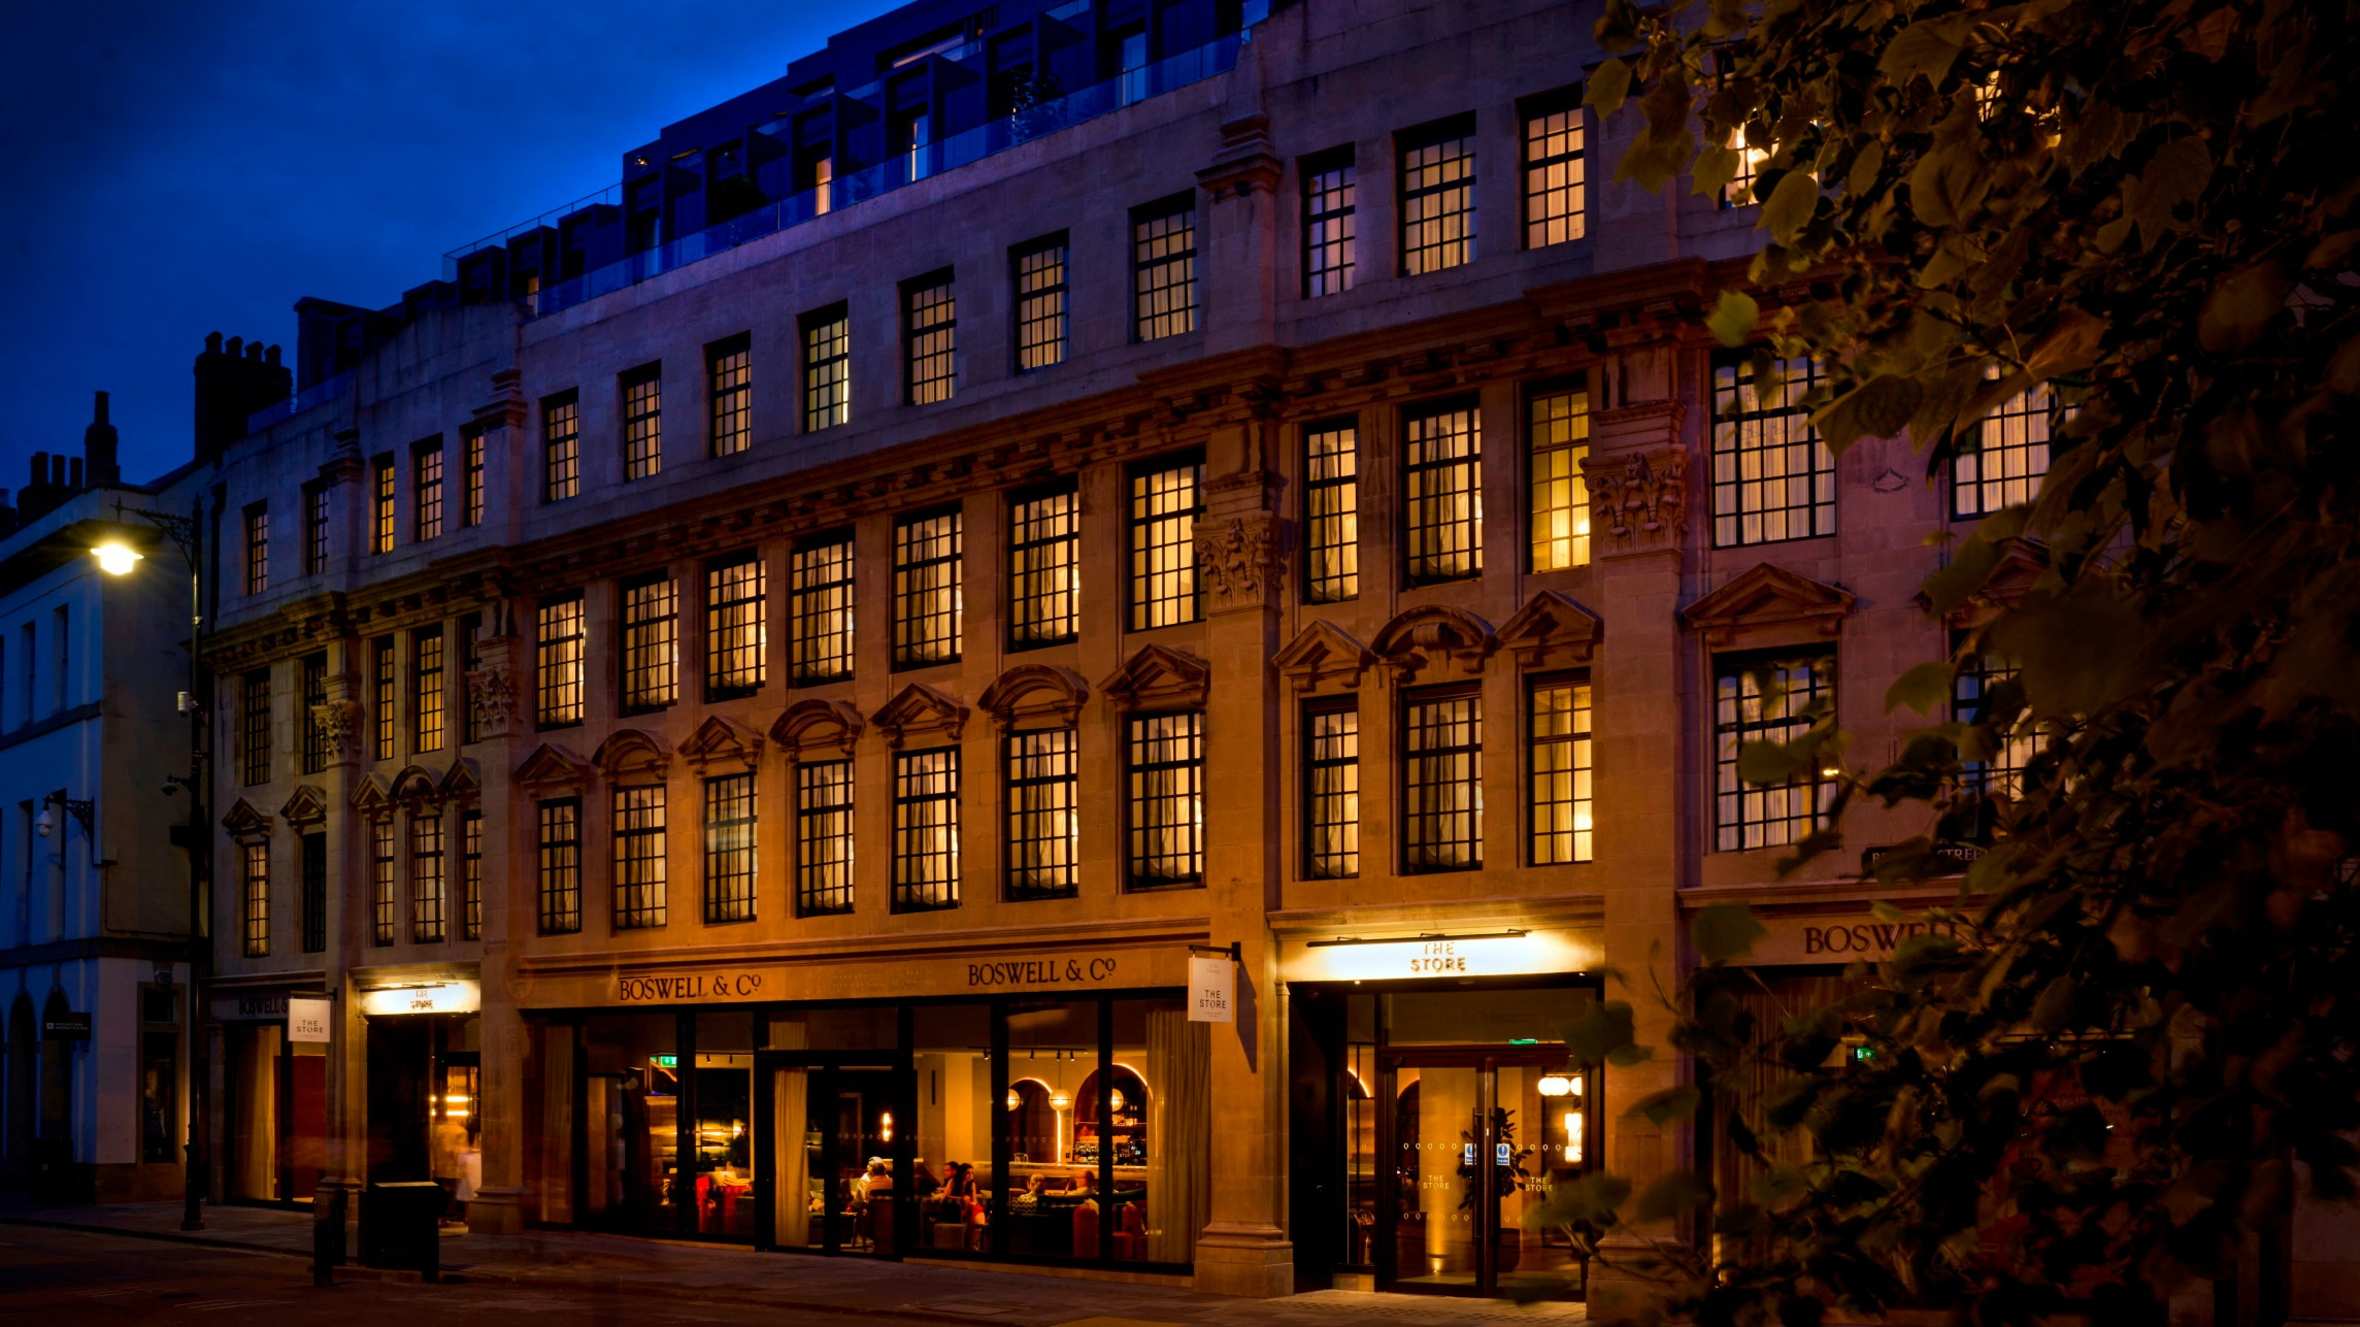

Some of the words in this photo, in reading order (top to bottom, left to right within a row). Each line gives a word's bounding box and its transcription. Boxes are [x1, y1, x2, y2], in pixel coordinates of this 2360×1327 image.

[1424, 943, 1454, 955] THE
[1410, 958, 1466, 972] STORE
[968, 961, 1060, 986] BOSWELL
[1066, 960, 1083, 981] &
[620, 976, 708, 1000] BOSWELL
[713, 976, 730, 996] &
[1204, 989, 1221, 999] THE
[1200, 999, 1227, 1008] STORE
[1423, 1182, 1450, 1190] STORE
